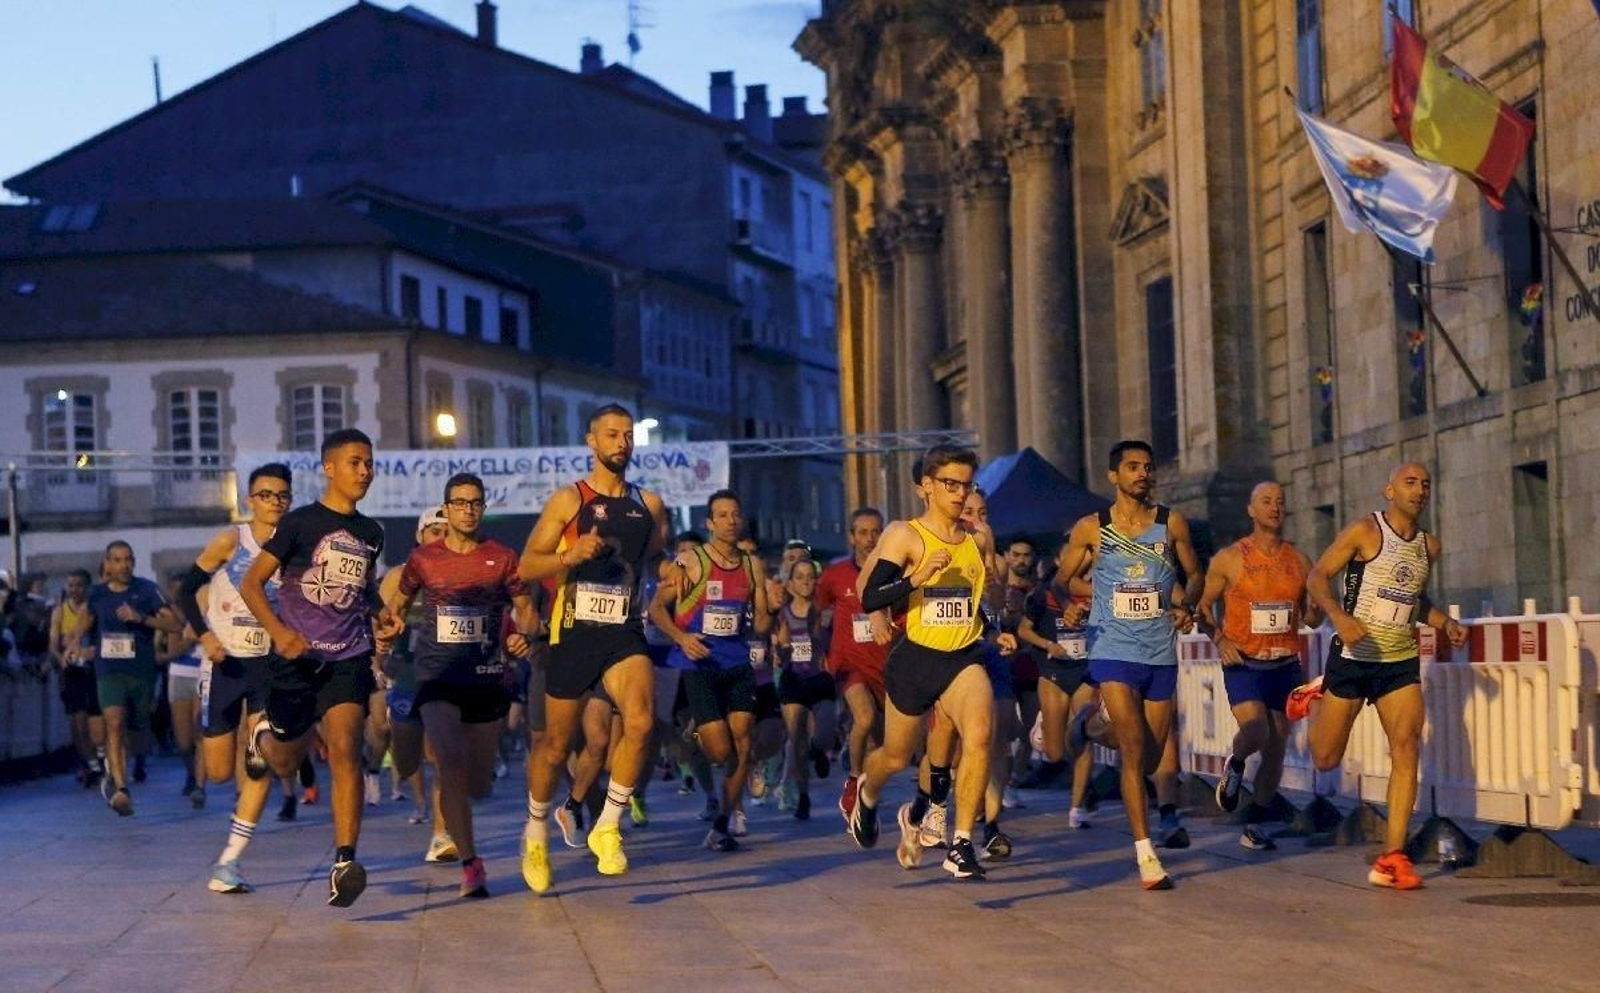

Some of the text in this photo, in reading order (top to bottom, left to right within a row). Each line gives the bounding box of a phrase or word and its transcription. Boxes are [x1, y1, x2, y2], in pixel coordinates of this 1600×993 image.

[339, 557, 363, 577] 326
[589, 597, 616, 614] 207
[936, 601, 962, 618] 306
[1128, 597, 1150, 612] 163
[449, 620, 475, 635] 249
[1269, 613, 1277, 627] 9
[244, 631, 265, 646] 401
